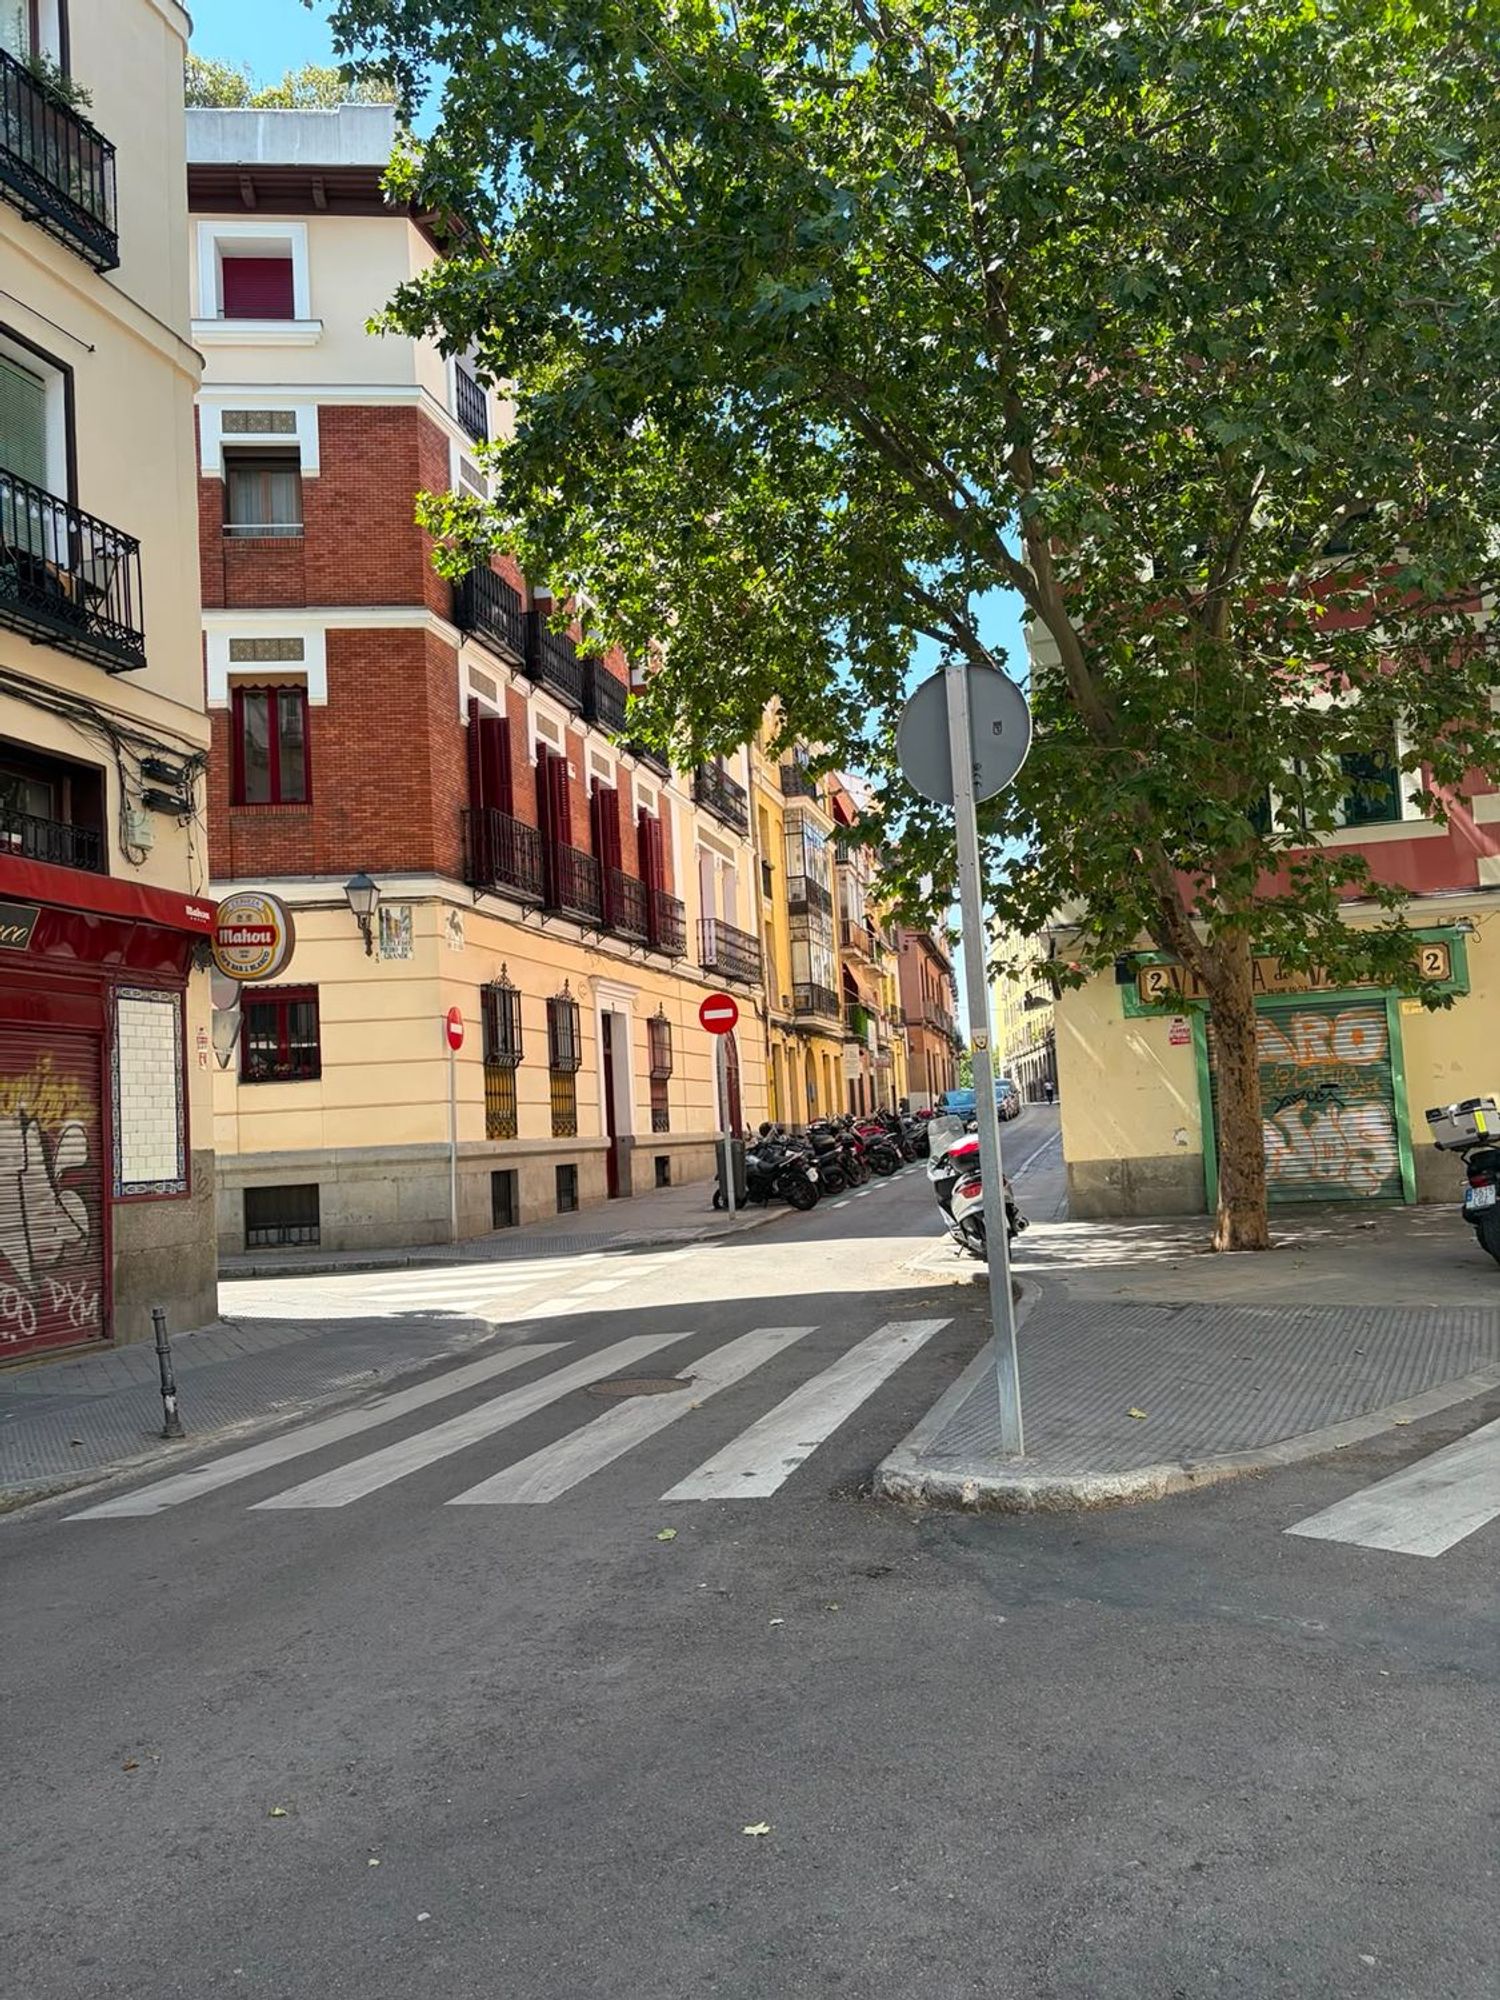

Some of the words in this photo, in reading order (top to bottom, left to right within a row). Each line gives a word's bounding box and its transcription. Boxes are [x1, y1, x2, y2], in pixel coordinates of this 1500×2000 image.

[185, 905, 211, 920] Mahou
[219, 928, 272, 945] Mahou
[1425, 952, 1440, 972] 2
[1150, 972, 1162, 992] 2
